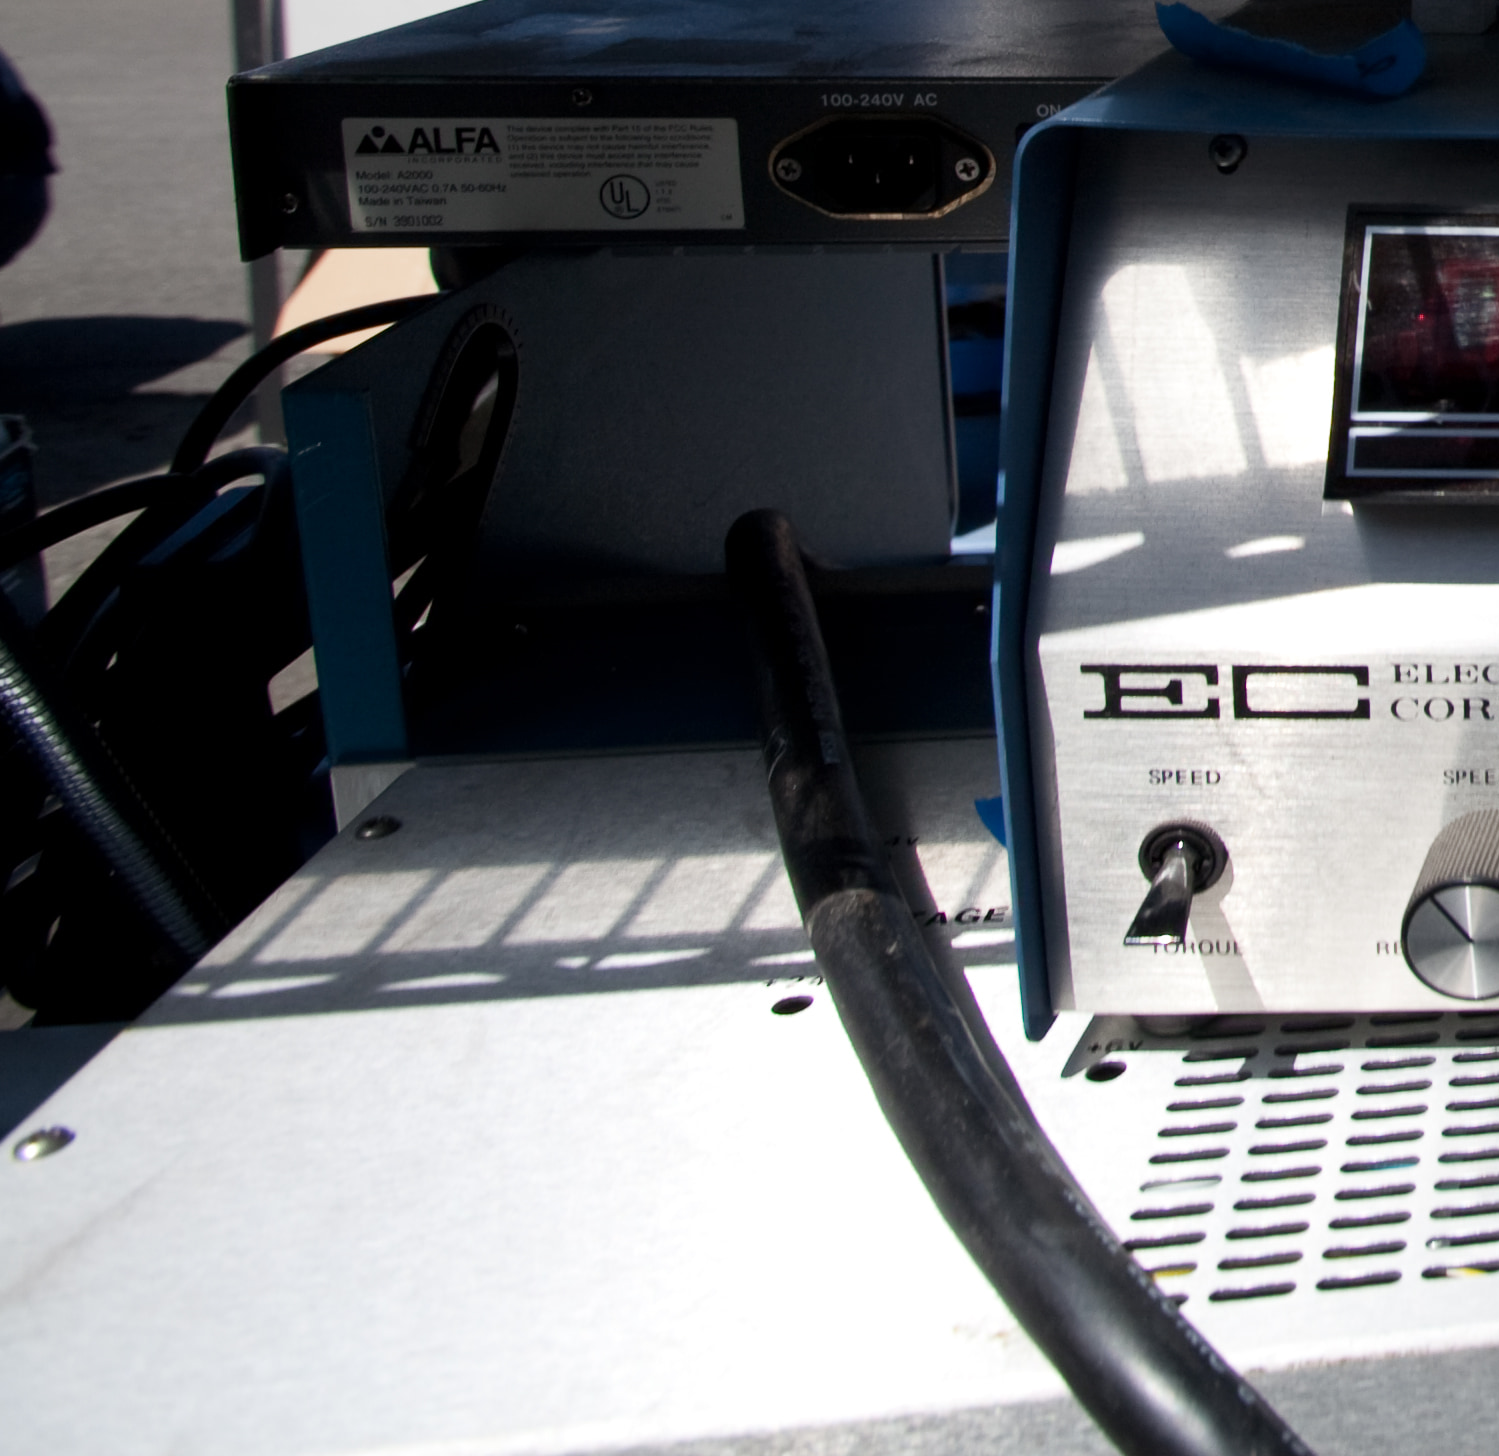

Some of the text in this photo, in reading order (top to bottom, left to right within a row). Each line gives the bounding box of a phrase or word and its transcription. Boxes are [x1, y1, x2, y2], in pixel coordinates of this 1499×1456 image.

[820, 91, 939, 108] 100-240V AC
[1036, 103, 1061, 118] ON
[407, 126, 501, 154] ALFA
[397, 170, 434, 180] A2000
[431, 183, 458, 194] 0.7A
[358, 196, 447, 206] Made in Taiwan
[609, 180, 640, 213] UL
[364, 216, 387, 227] S/N
[1147, 767, 1221, 787] SPEED
